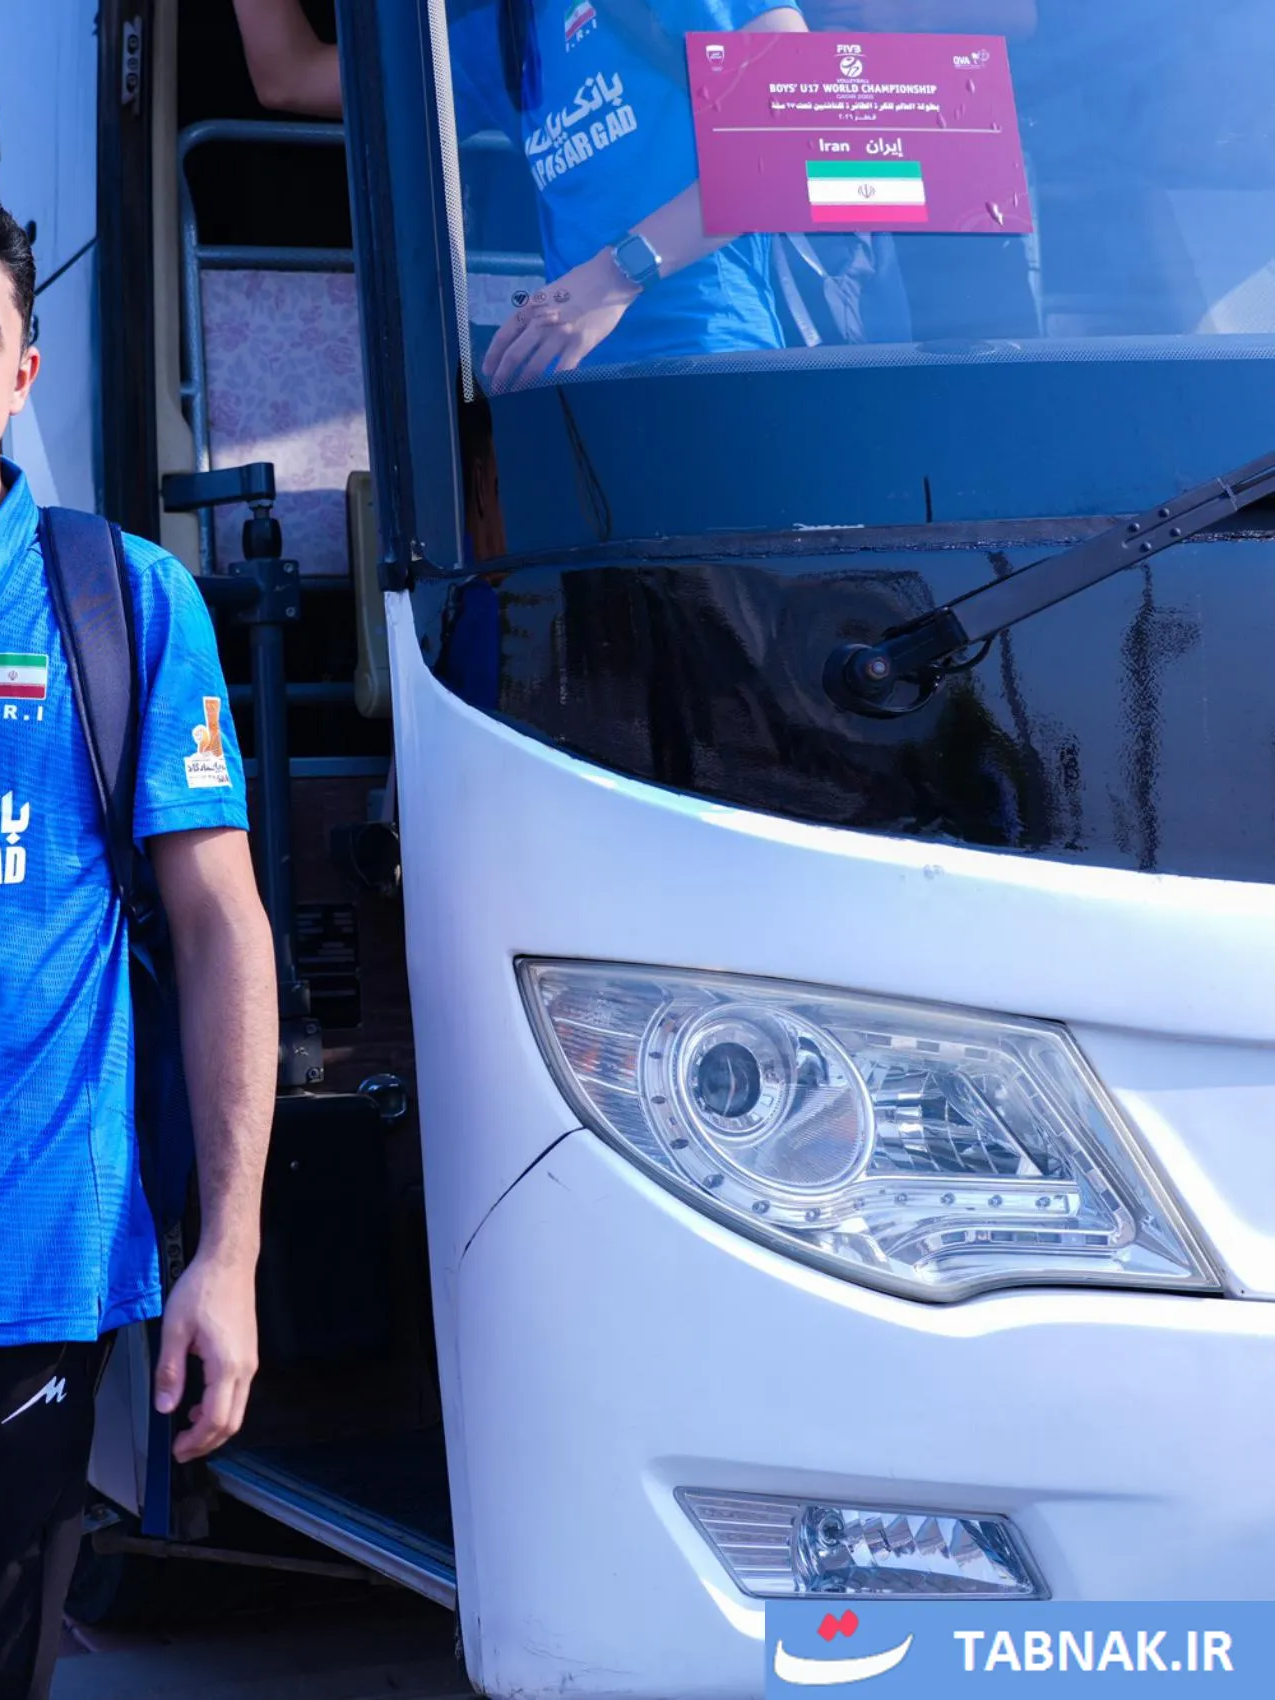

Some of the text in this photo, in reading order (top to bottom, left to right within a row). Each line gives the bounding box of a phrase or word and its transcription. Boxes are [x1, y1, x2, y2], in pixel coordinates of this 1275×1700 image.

[836, 44, 862, 53] FIVB
[799, 83, 819, 93] U17
[822, 83, 859, 94] WORLD
[861, 84, 937, 94] CHAMPIONSHIP
[819, 138, 850, 152] Iran
[866, 137, 904, 157] إيران
